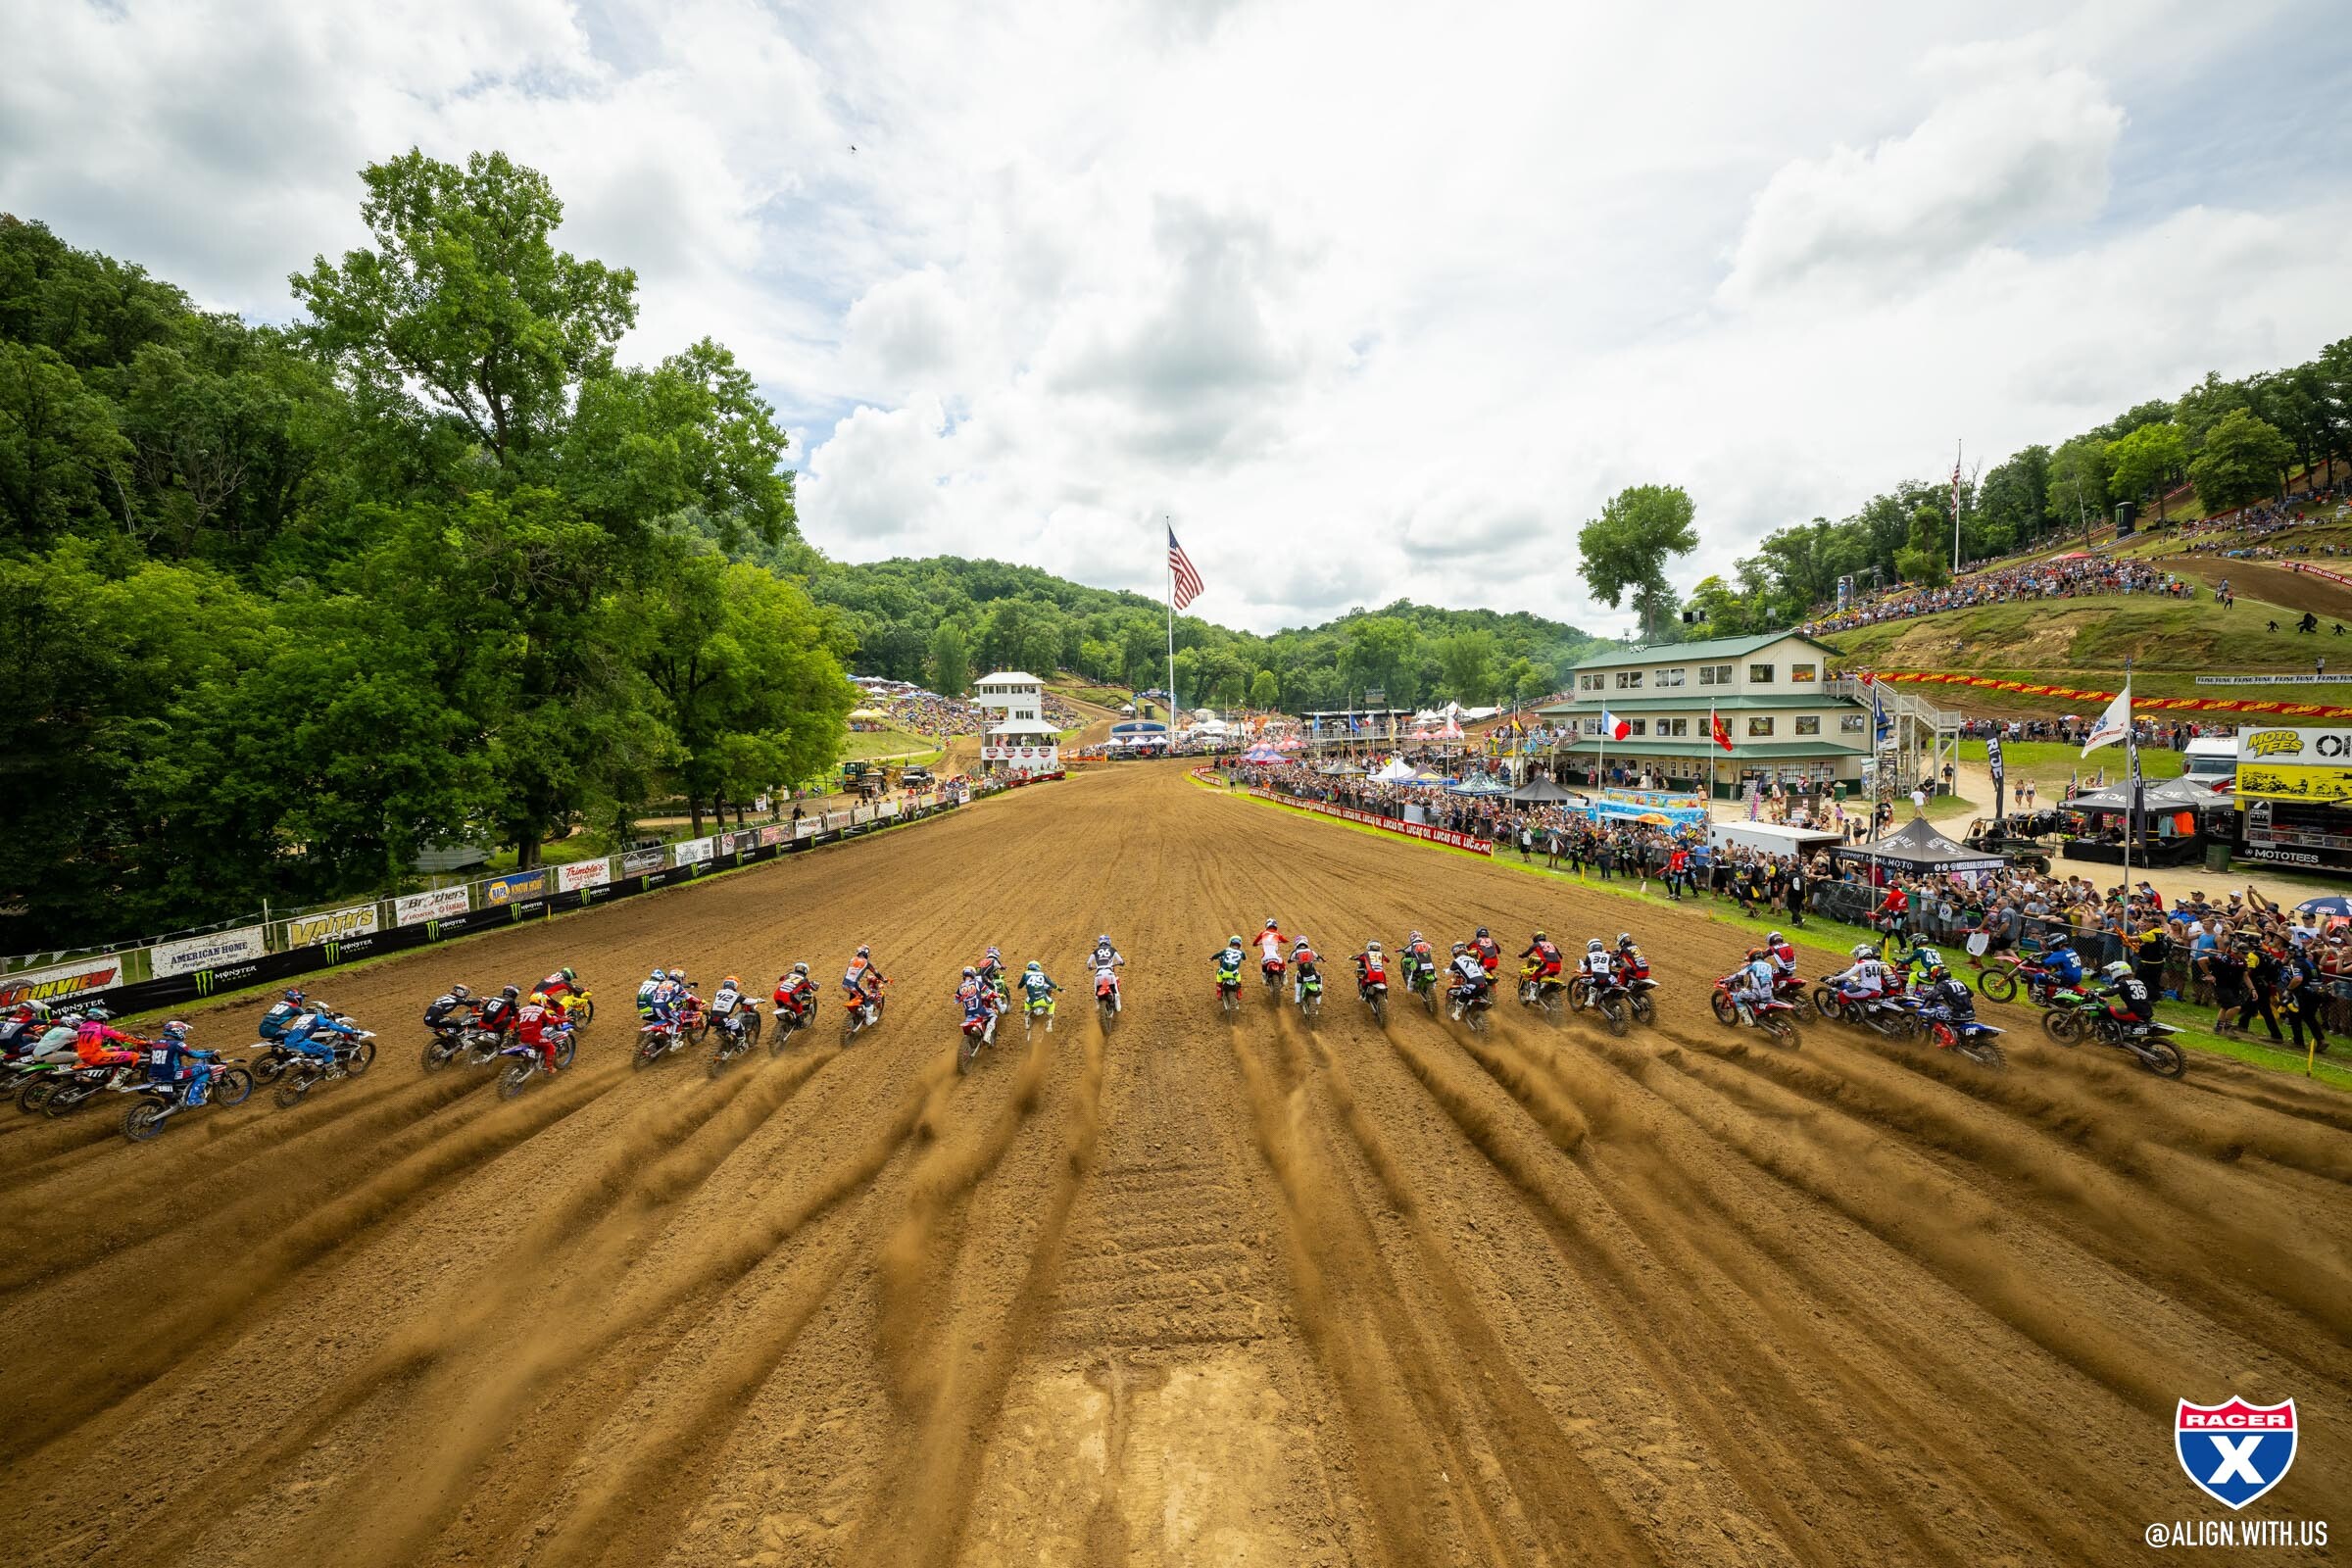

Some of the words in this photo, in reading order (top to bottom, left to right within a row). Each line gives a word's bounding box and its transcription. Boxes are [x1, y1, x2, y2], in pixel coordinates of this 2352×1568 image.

[2249, 730, 2297, 748] MOTO
[2256, 741, 2303, 757] TEES
[1383, 818, 1396, 830] LUCAS
[1406, 823, 1423, 836] LUCAS
[1433, 830, 1450, 844] LUCAS
[1451, 834, 1461, 846] OIL
[2255, 849, 2319, 863] MOTOTEES
[1887, 858, 1913, 870] MOTO
[492, 887, 507, 899] NAPA
[445, 902, 466, 911] YAMAHA
[290, 909, 373, 948] VAITH'S
[439, 918, 466, 928] MONSTER
[340, 939, 372, 951] MONSTER
[171, 946, 220, 965] AMERICAN
[221, 942, 248, 955] HOME
[1097, 948, 1111, 957] 96
[1224, 951, 1242, 965] 32
[1463, 958, 1476, 968] 74
[1592, 956, 1608, 964] 38
[215, 965, 257, 980] MONSTER
[1865, 966, 1880, 978] 544
[1026, 975, 1045, 987] 49
[716, 993, 733, 1003] 42
[51, 998, 106, 1016] MONSTER
